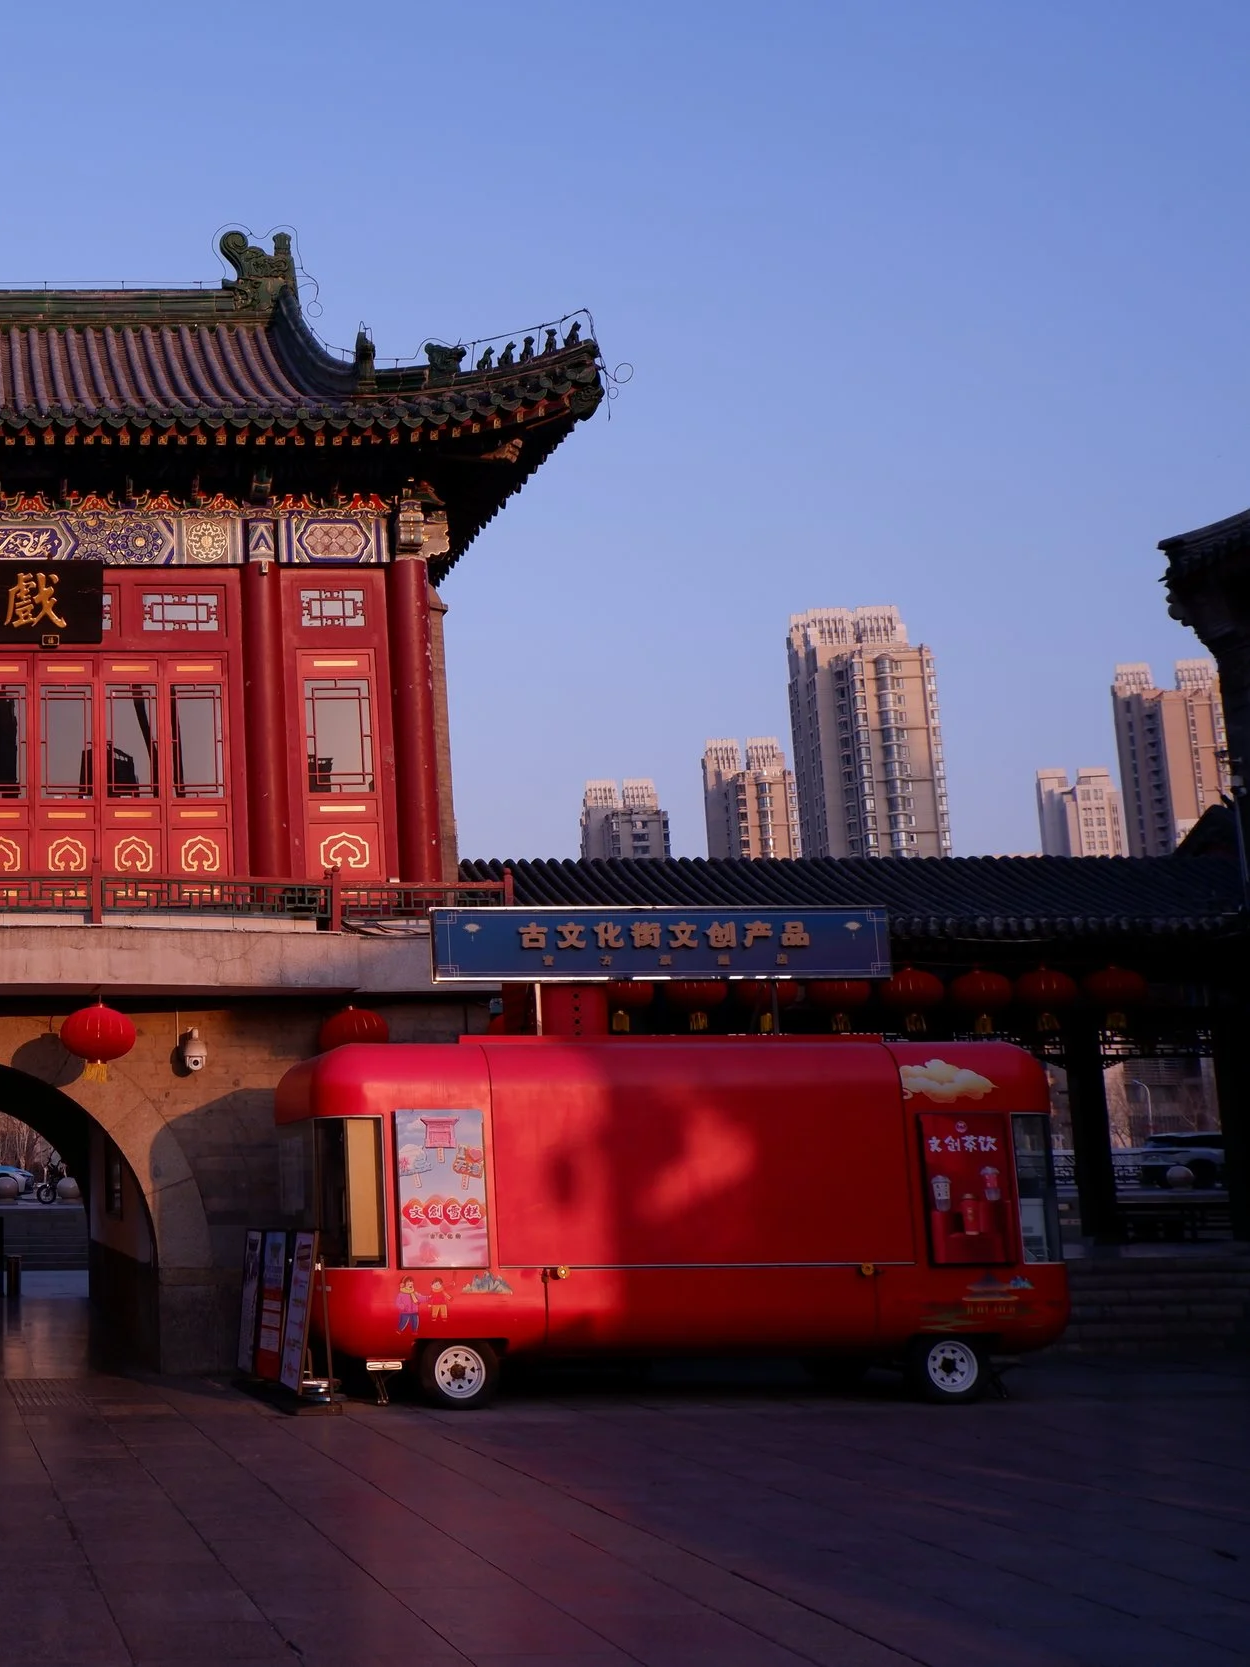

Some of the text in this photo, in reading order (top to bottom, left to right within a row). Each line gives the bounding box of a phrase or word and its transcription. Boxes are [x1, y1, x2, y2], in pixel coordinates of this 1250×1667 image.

[518, 920, 811, 949] 古文化街文创产品
[928, 1135, 999, 1153] 文创茶饮
